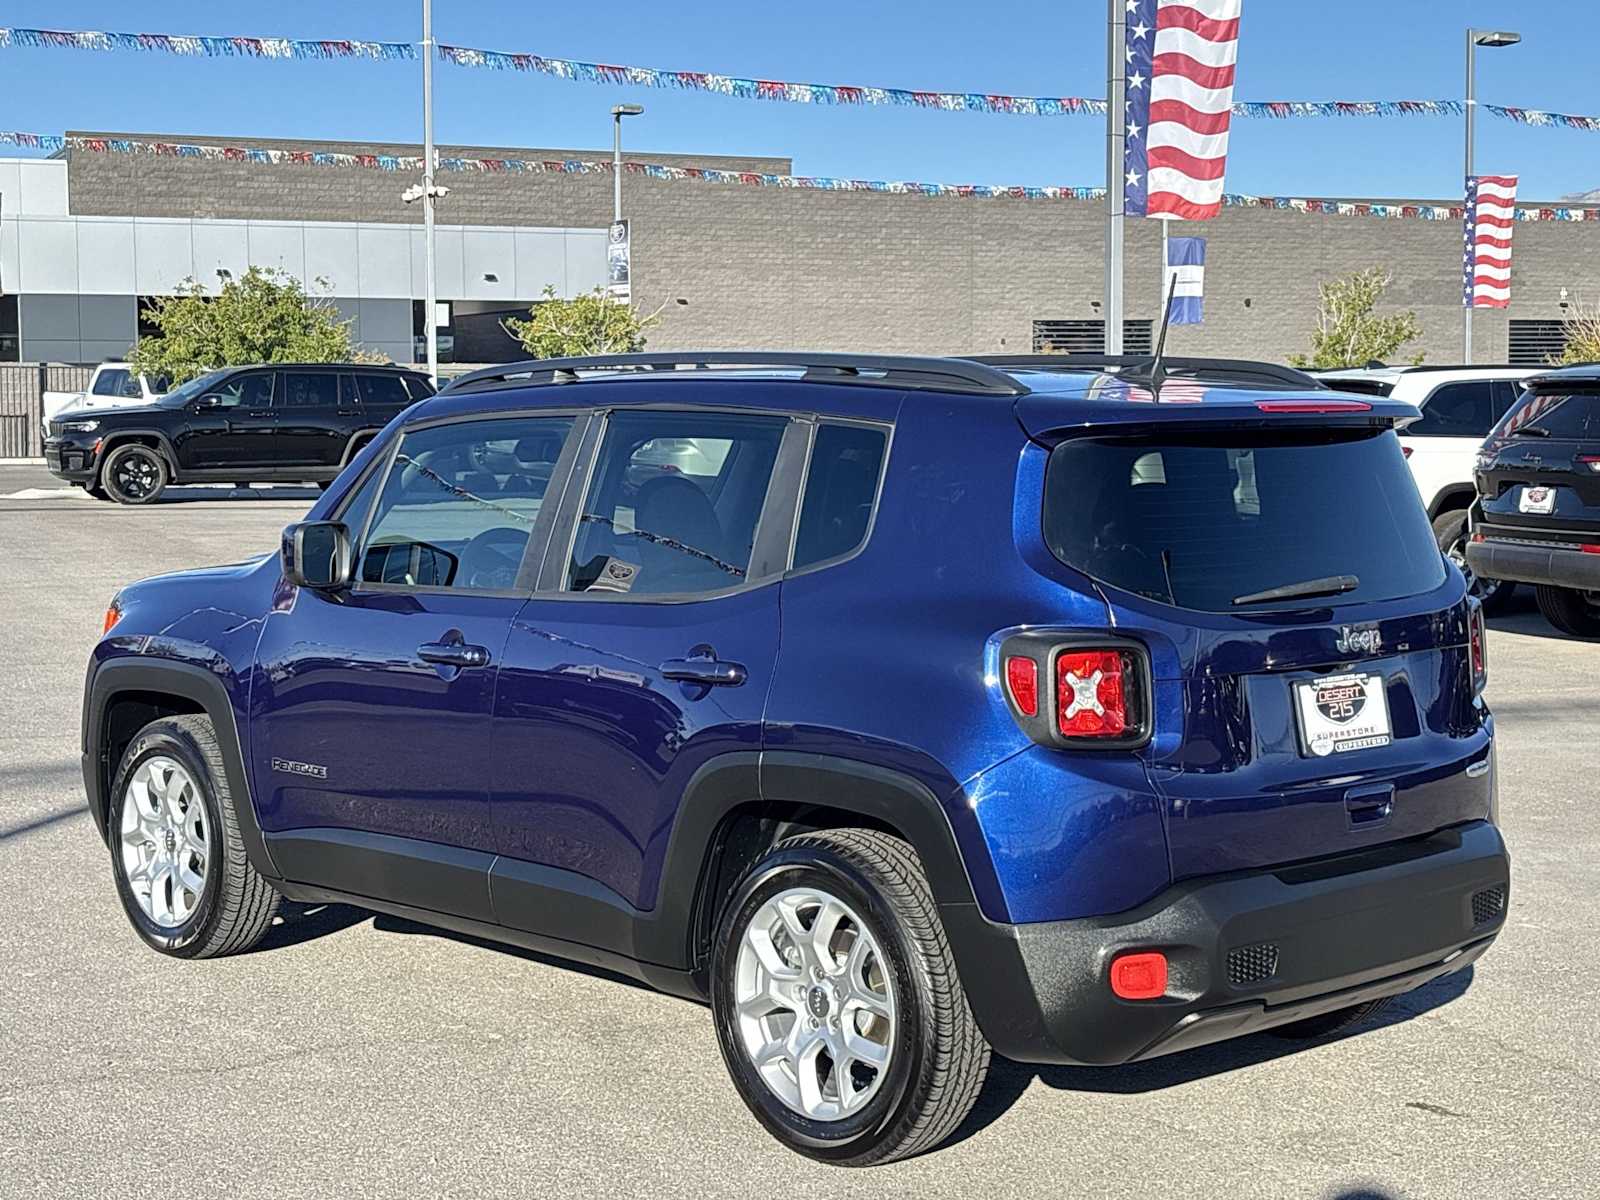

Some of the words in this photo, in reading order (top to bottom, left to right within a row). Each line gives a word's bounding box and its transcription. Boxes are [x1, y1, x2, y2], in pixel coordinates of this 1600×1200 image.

[1336, 626, 1381, 654] Jeep
[1318, 686, 1361, 702] DESERT
[1328, 701, 1354, 719] 215
[1316, 727, 1375, 740] SUPERSTORE
[272, 757, 327, 778] RENEGADE
